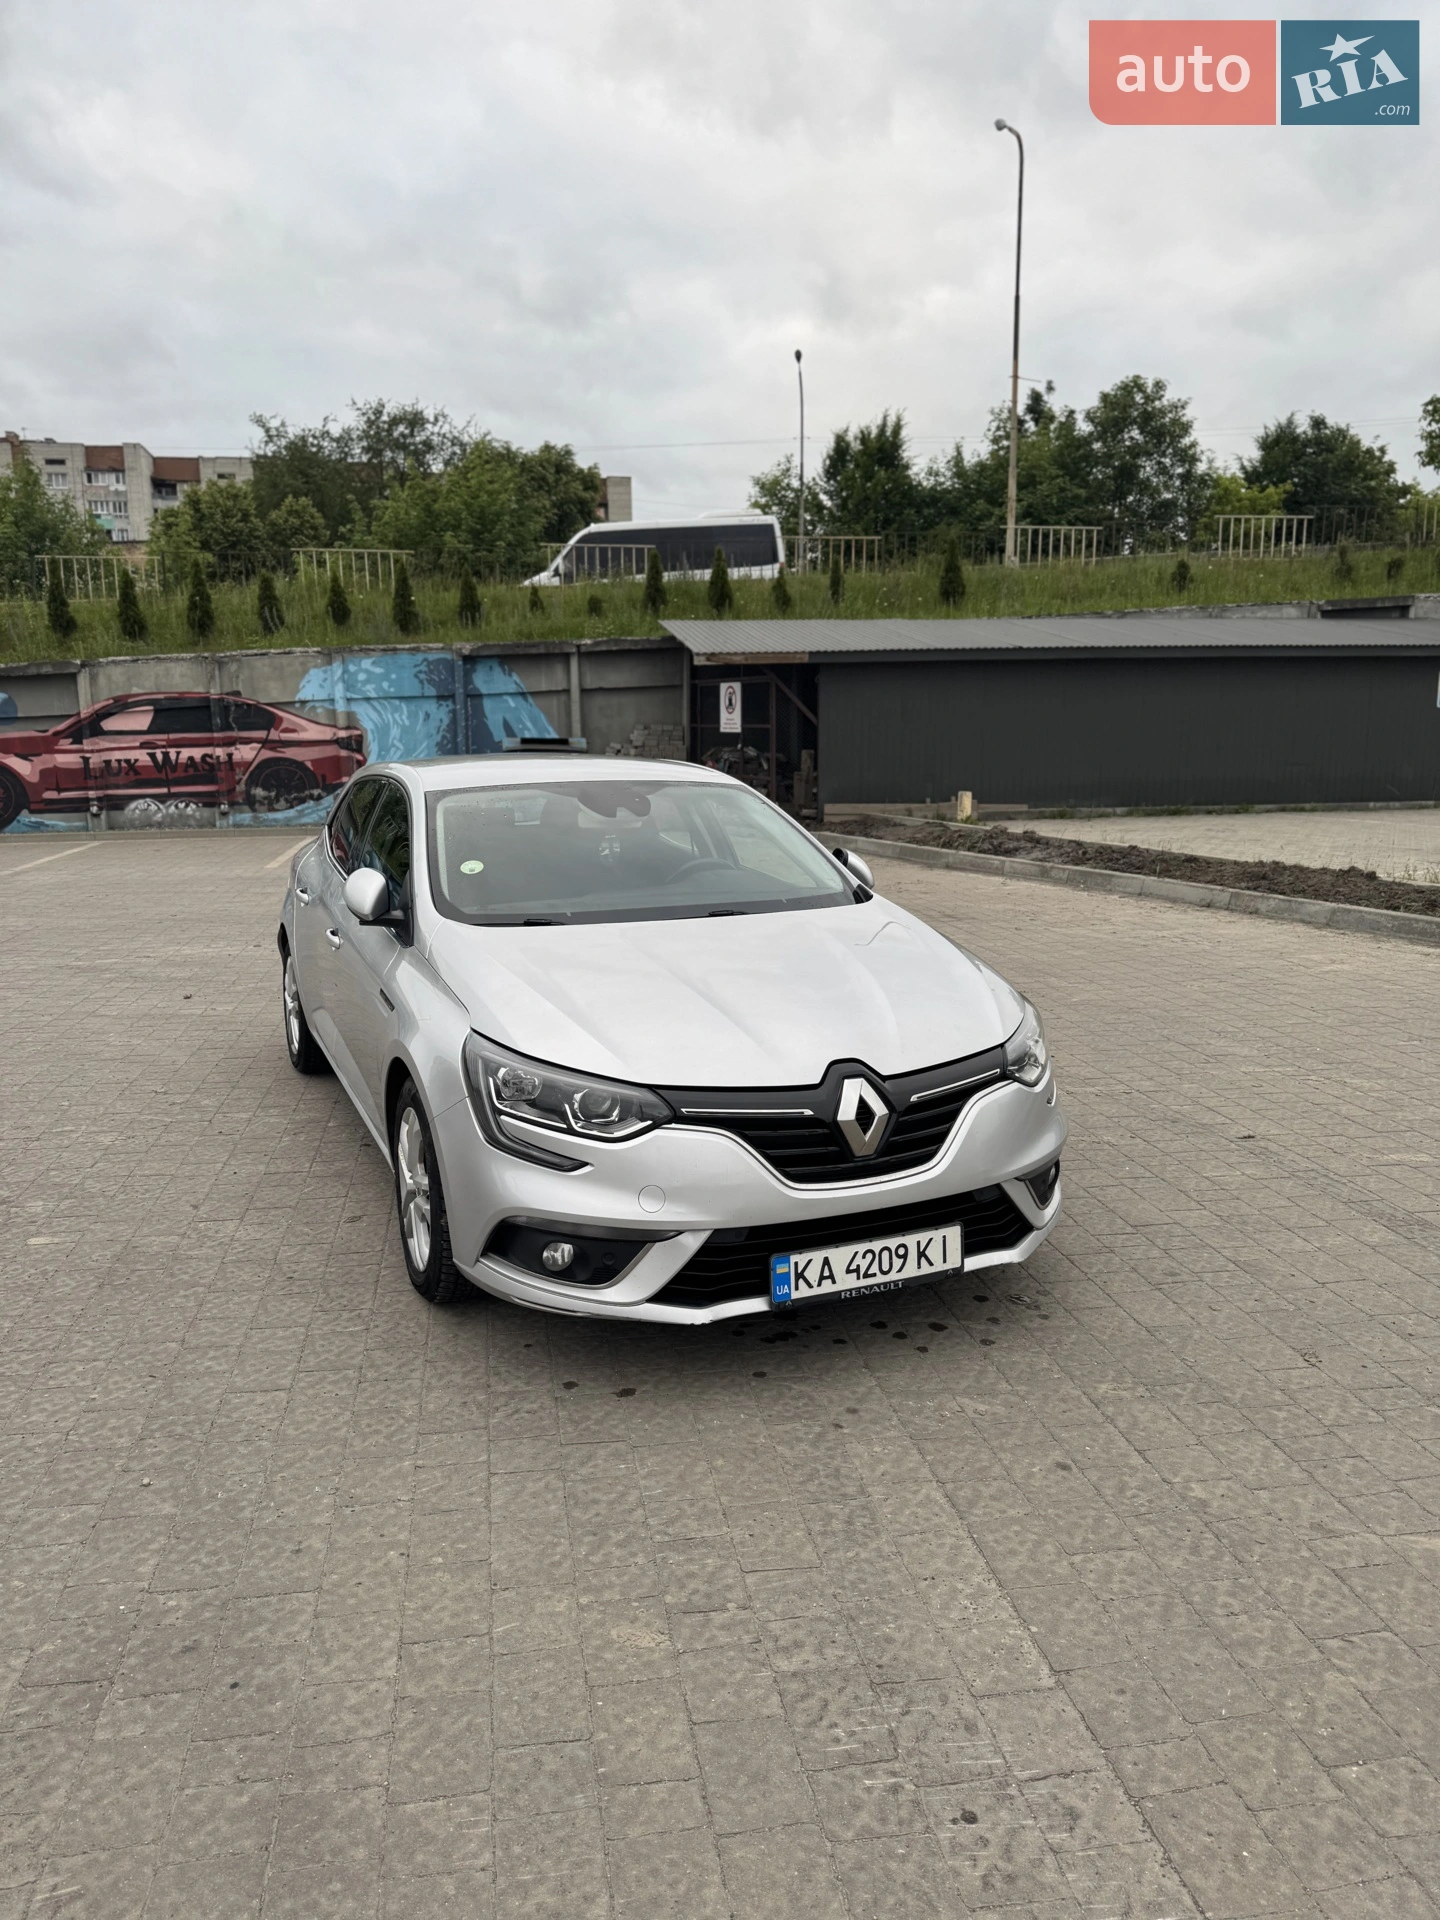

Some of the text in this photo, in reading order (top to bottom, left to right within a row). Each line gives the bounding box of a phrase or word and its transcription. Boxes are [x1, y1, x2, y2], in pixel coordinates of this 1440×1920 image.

[793, 1235, 947, 1292] KA 4209 KI
[776, 1284, 790, 1295] UA
[841, 1281, 904, 1299] RENAULT
